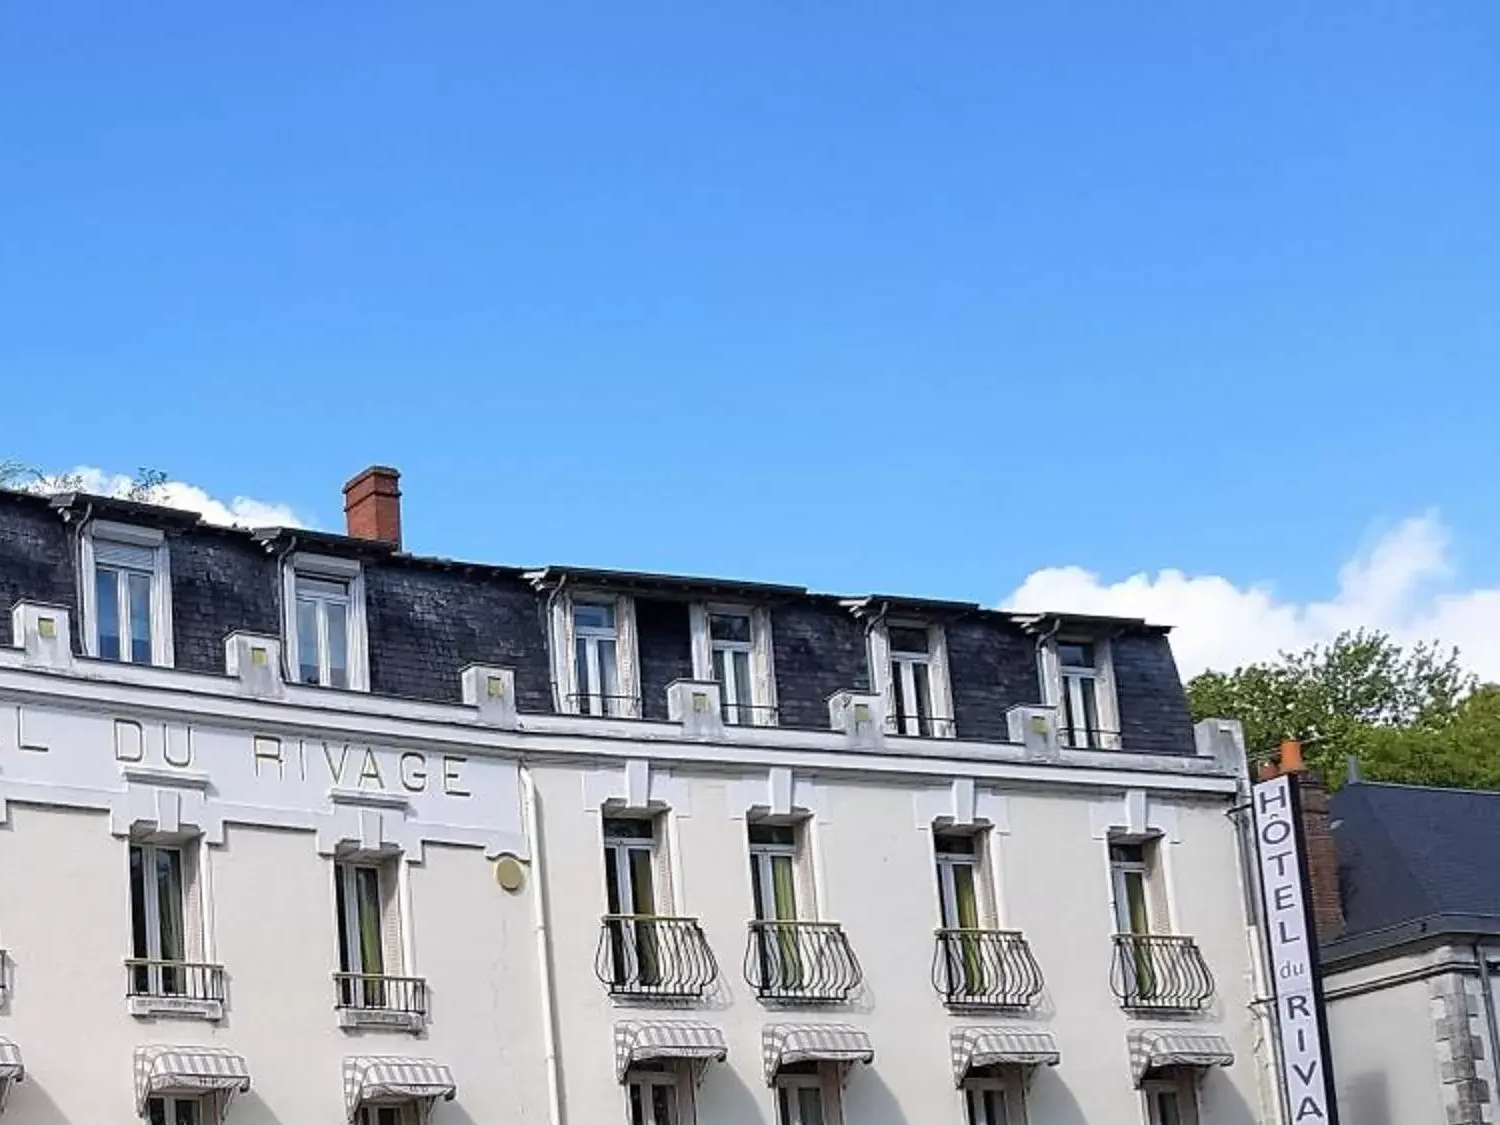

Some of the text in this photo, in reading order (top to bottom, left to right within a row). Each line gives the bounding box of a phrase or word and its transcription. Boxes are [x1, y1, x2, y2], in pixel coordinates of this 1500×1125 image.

[113, 718, 193, 767] DU
[253, 734, 472, 797] RIVAGE
[1258, 785, 1302, 945] HÔTEL
[1279, 959, 1306, 981] du
